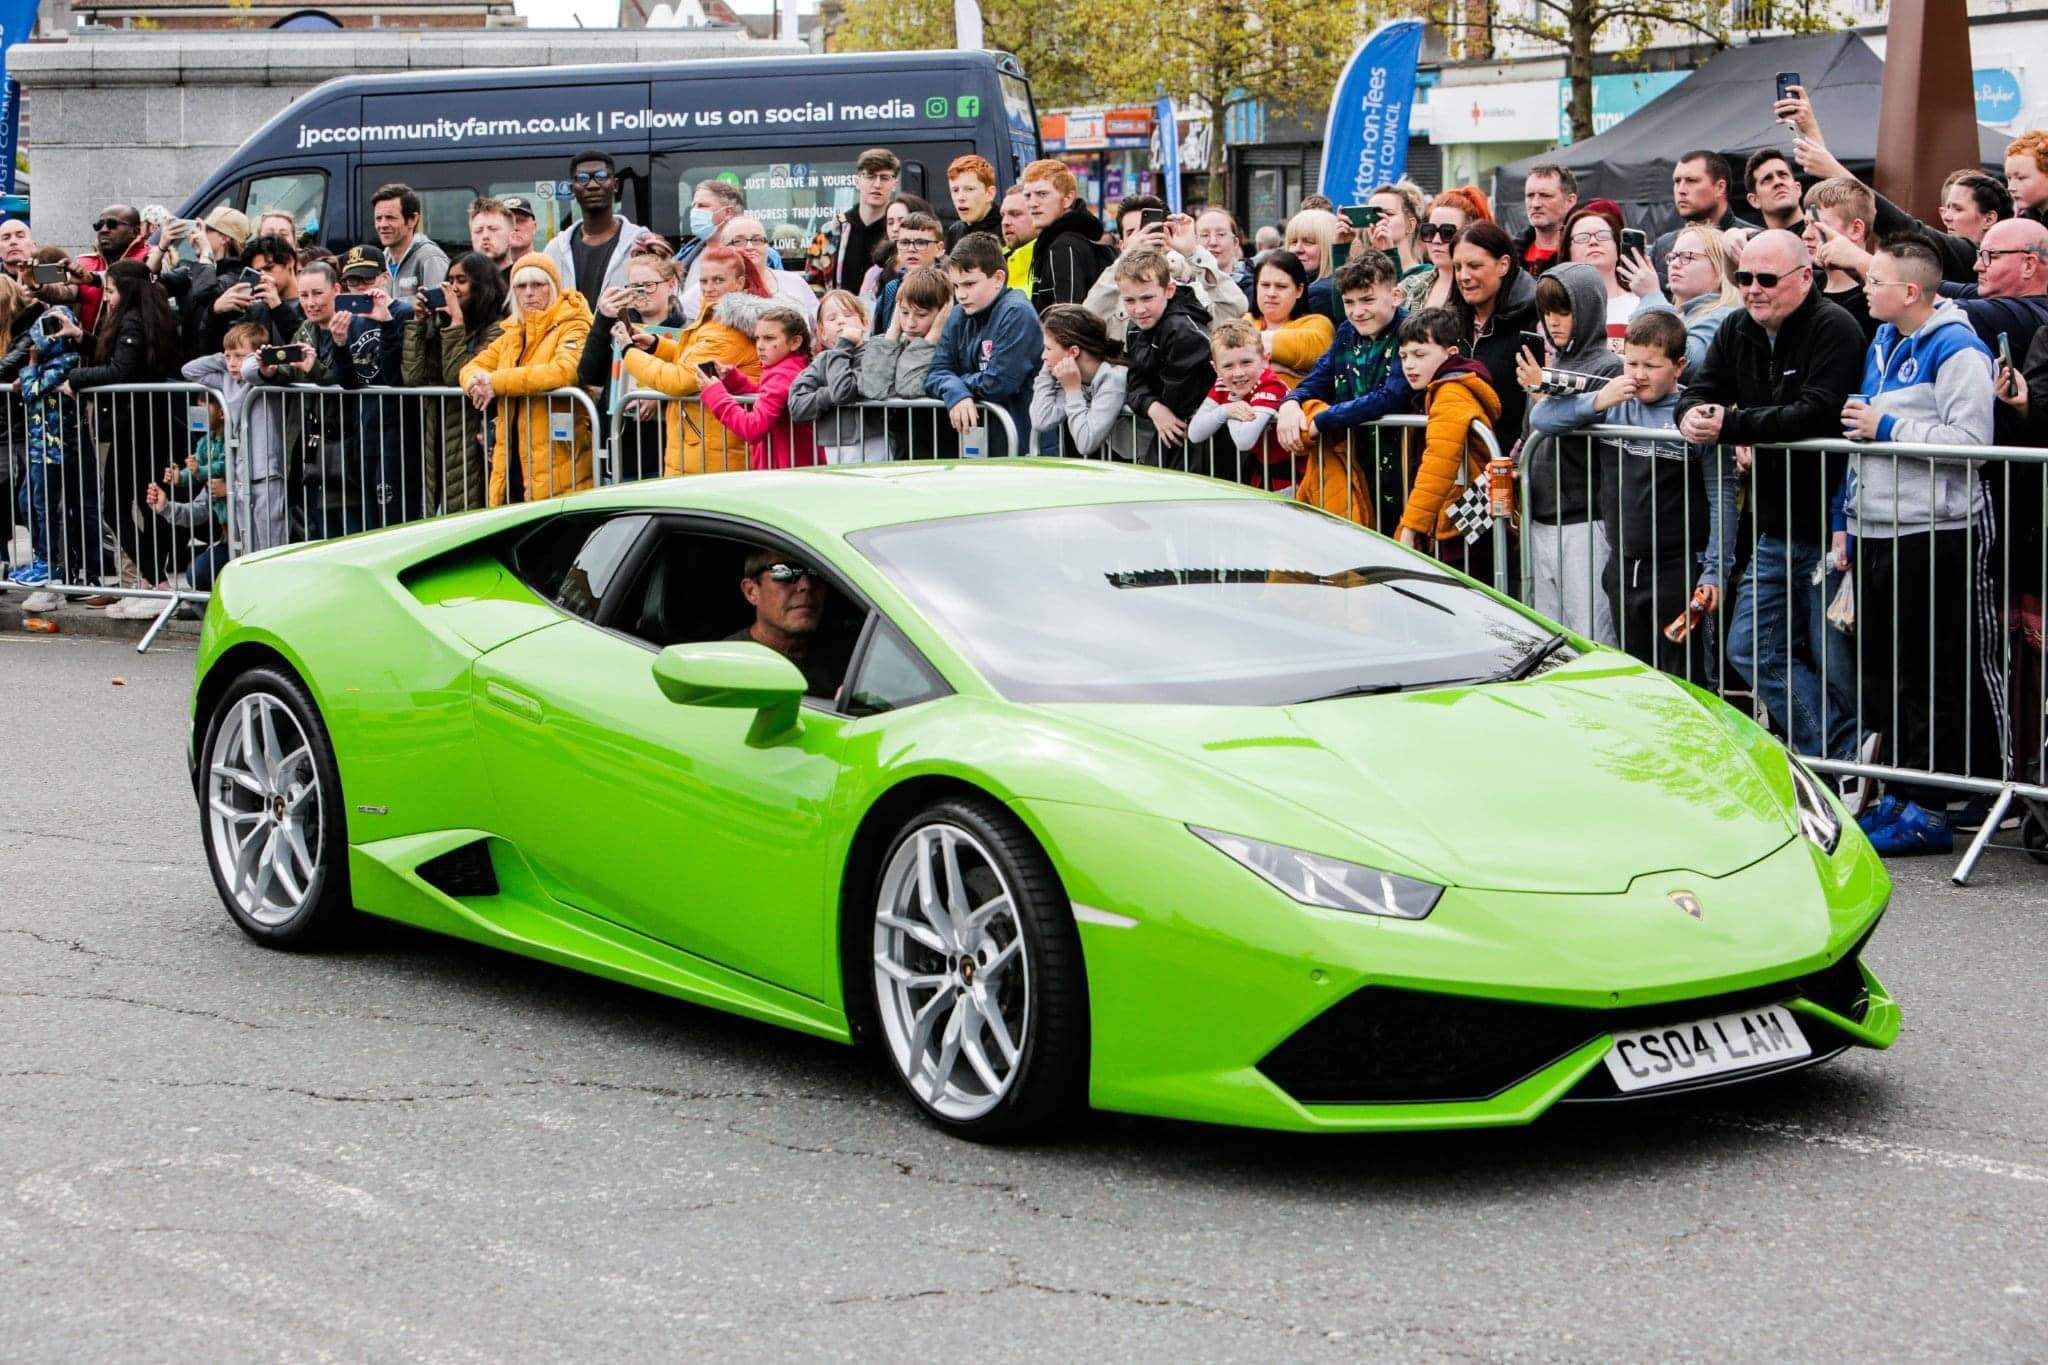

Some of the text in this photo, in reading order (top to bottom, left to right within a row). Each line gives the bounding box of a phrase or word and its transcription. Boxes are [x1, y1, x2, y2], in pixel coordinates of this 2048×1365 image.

[297, 113, 590, 148] jpccommunityfarm.co.uk
[610, 109, 688, 130] Follow
[694, 109, 723, 126] us
[728, 109, 758, 125] on
[764, 102, 833, 124] social
[840, 99, 915, 121] media
[1380, 101, 1401, 166] COUNCIL
[744, 174, 856, 190] JUST BELIEVE IN YOURSE
[774, 238, 796, 249] LOVE
